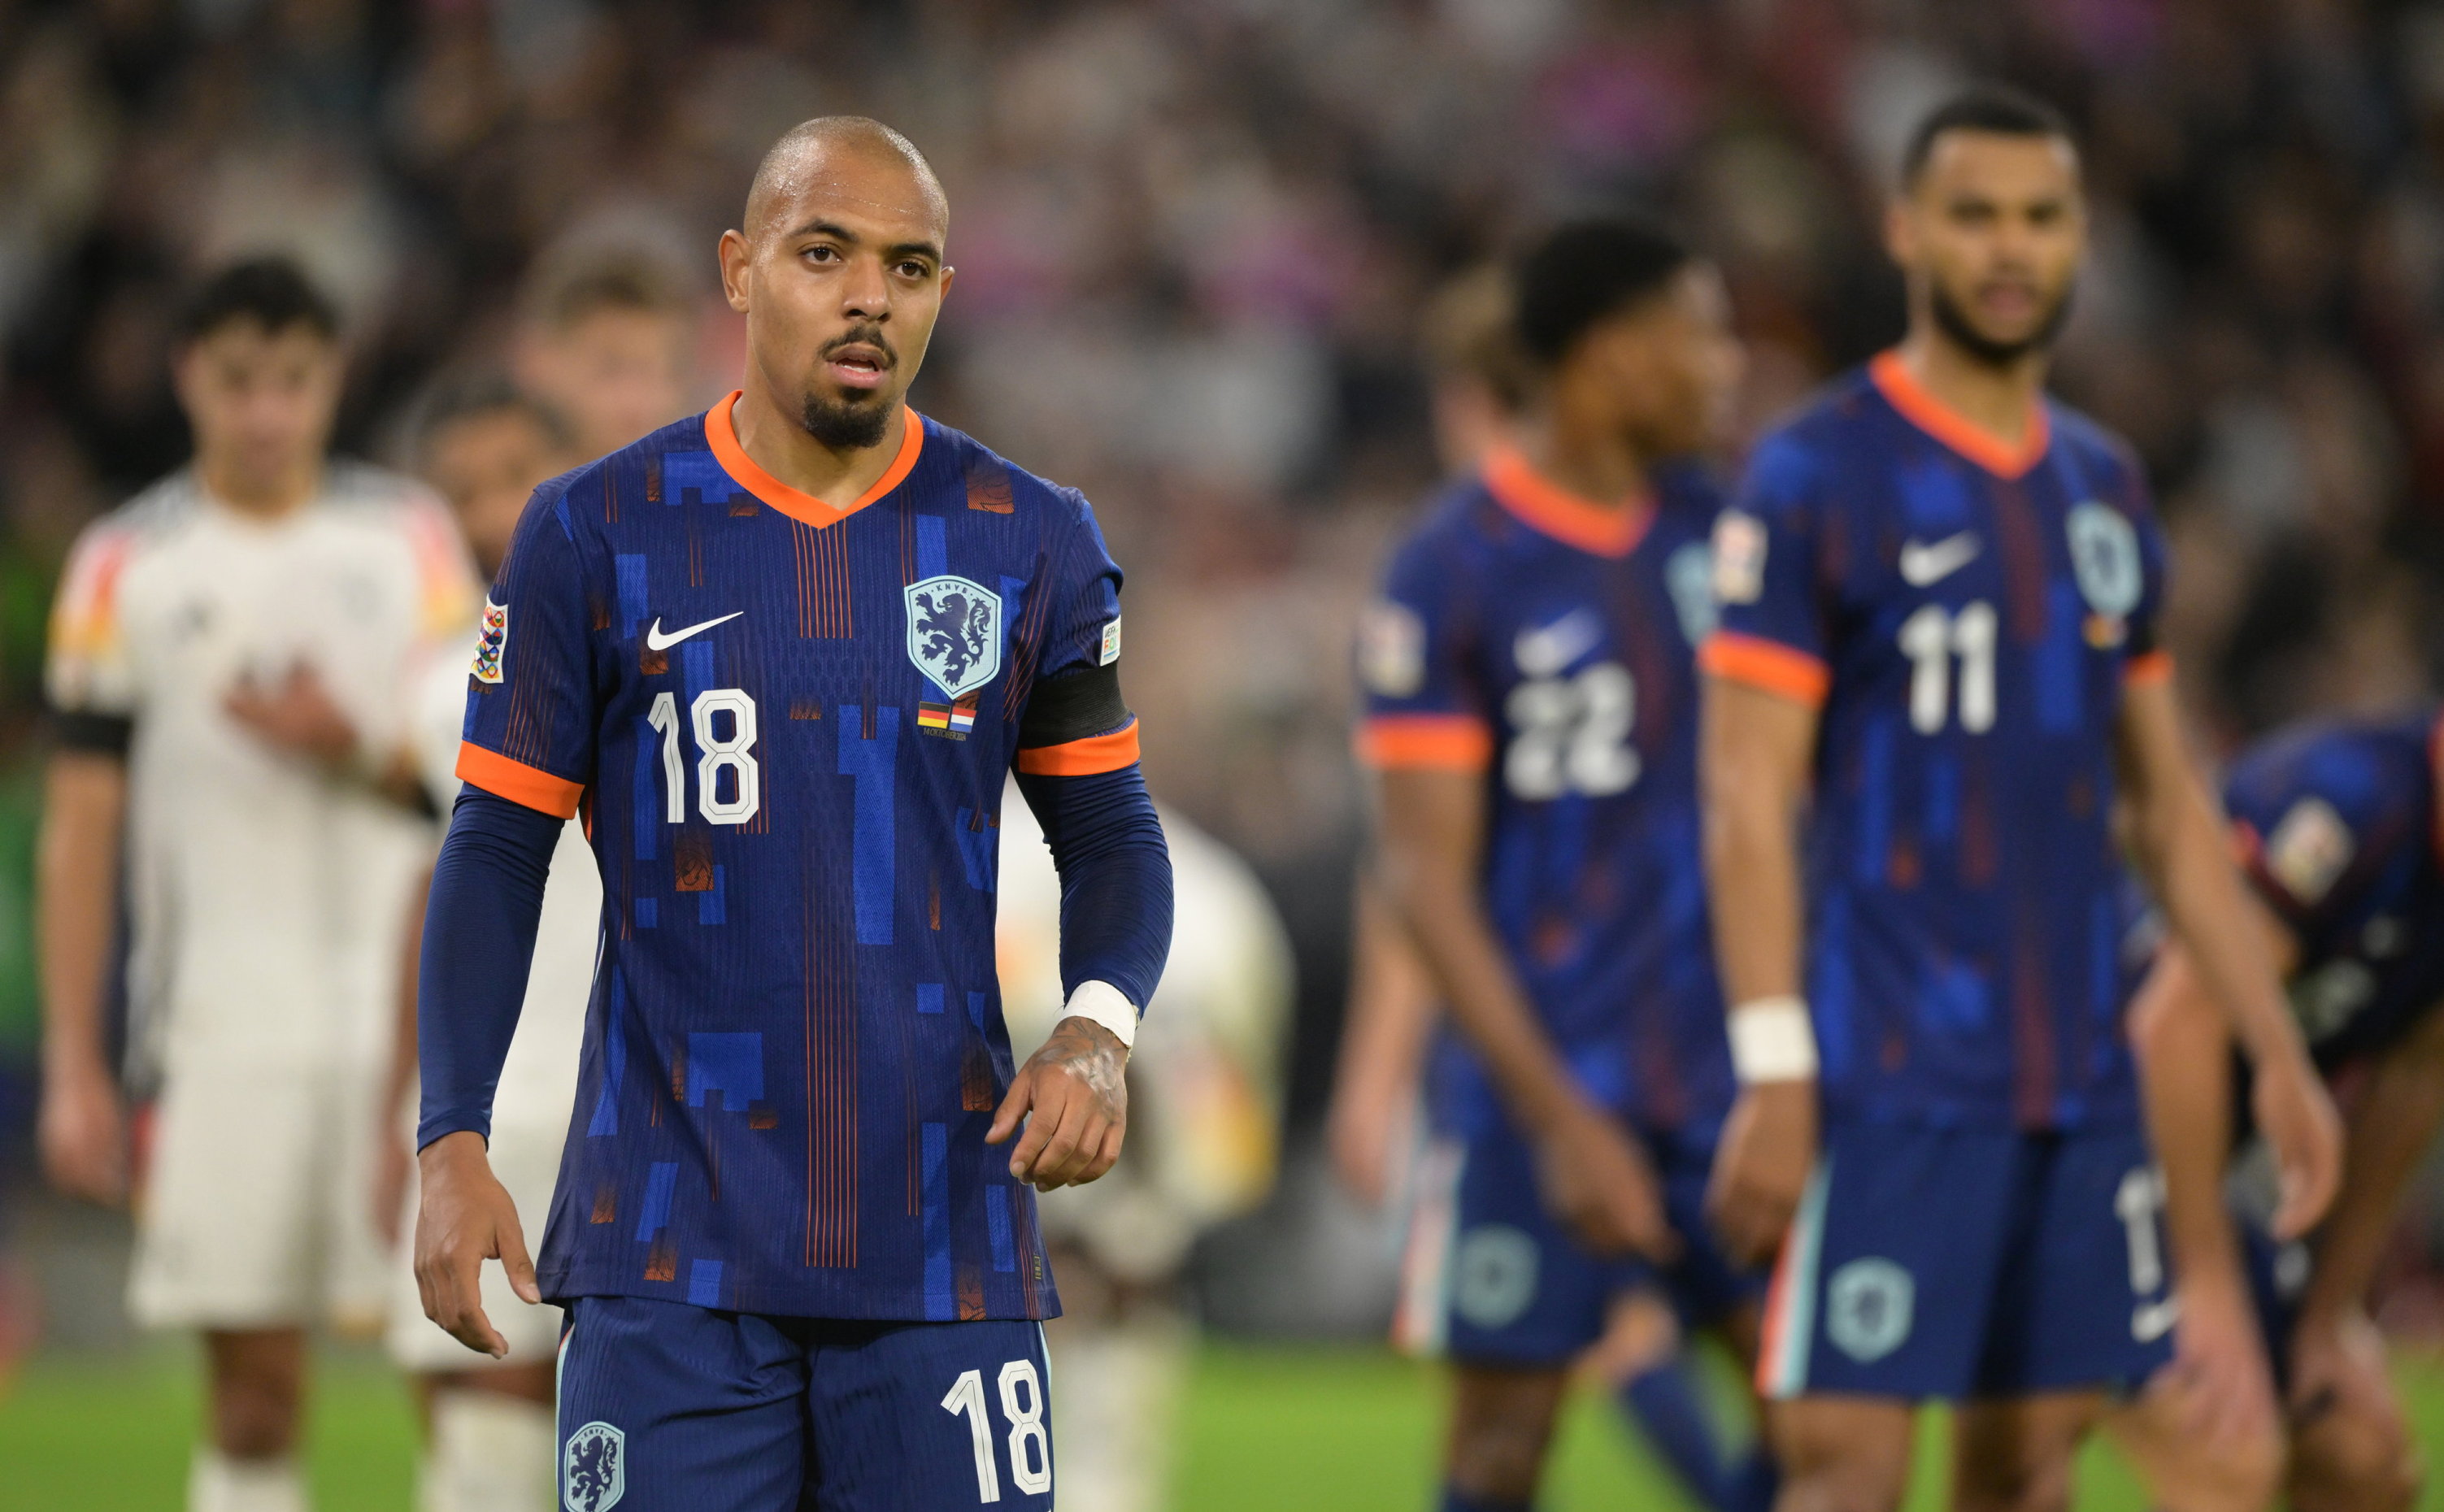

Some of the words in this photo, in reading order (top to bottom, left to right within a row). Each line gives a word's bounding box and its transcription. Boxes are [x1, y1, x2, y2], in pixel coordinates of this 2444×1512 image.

[936, 583, 968, 594] KNVB
[1506, 663, 1639, 801] 22
[1899, 599, 1998, 735] 11
[647, 689, 759, 825] 18
[941, 1359, 1050, 1503] 18
